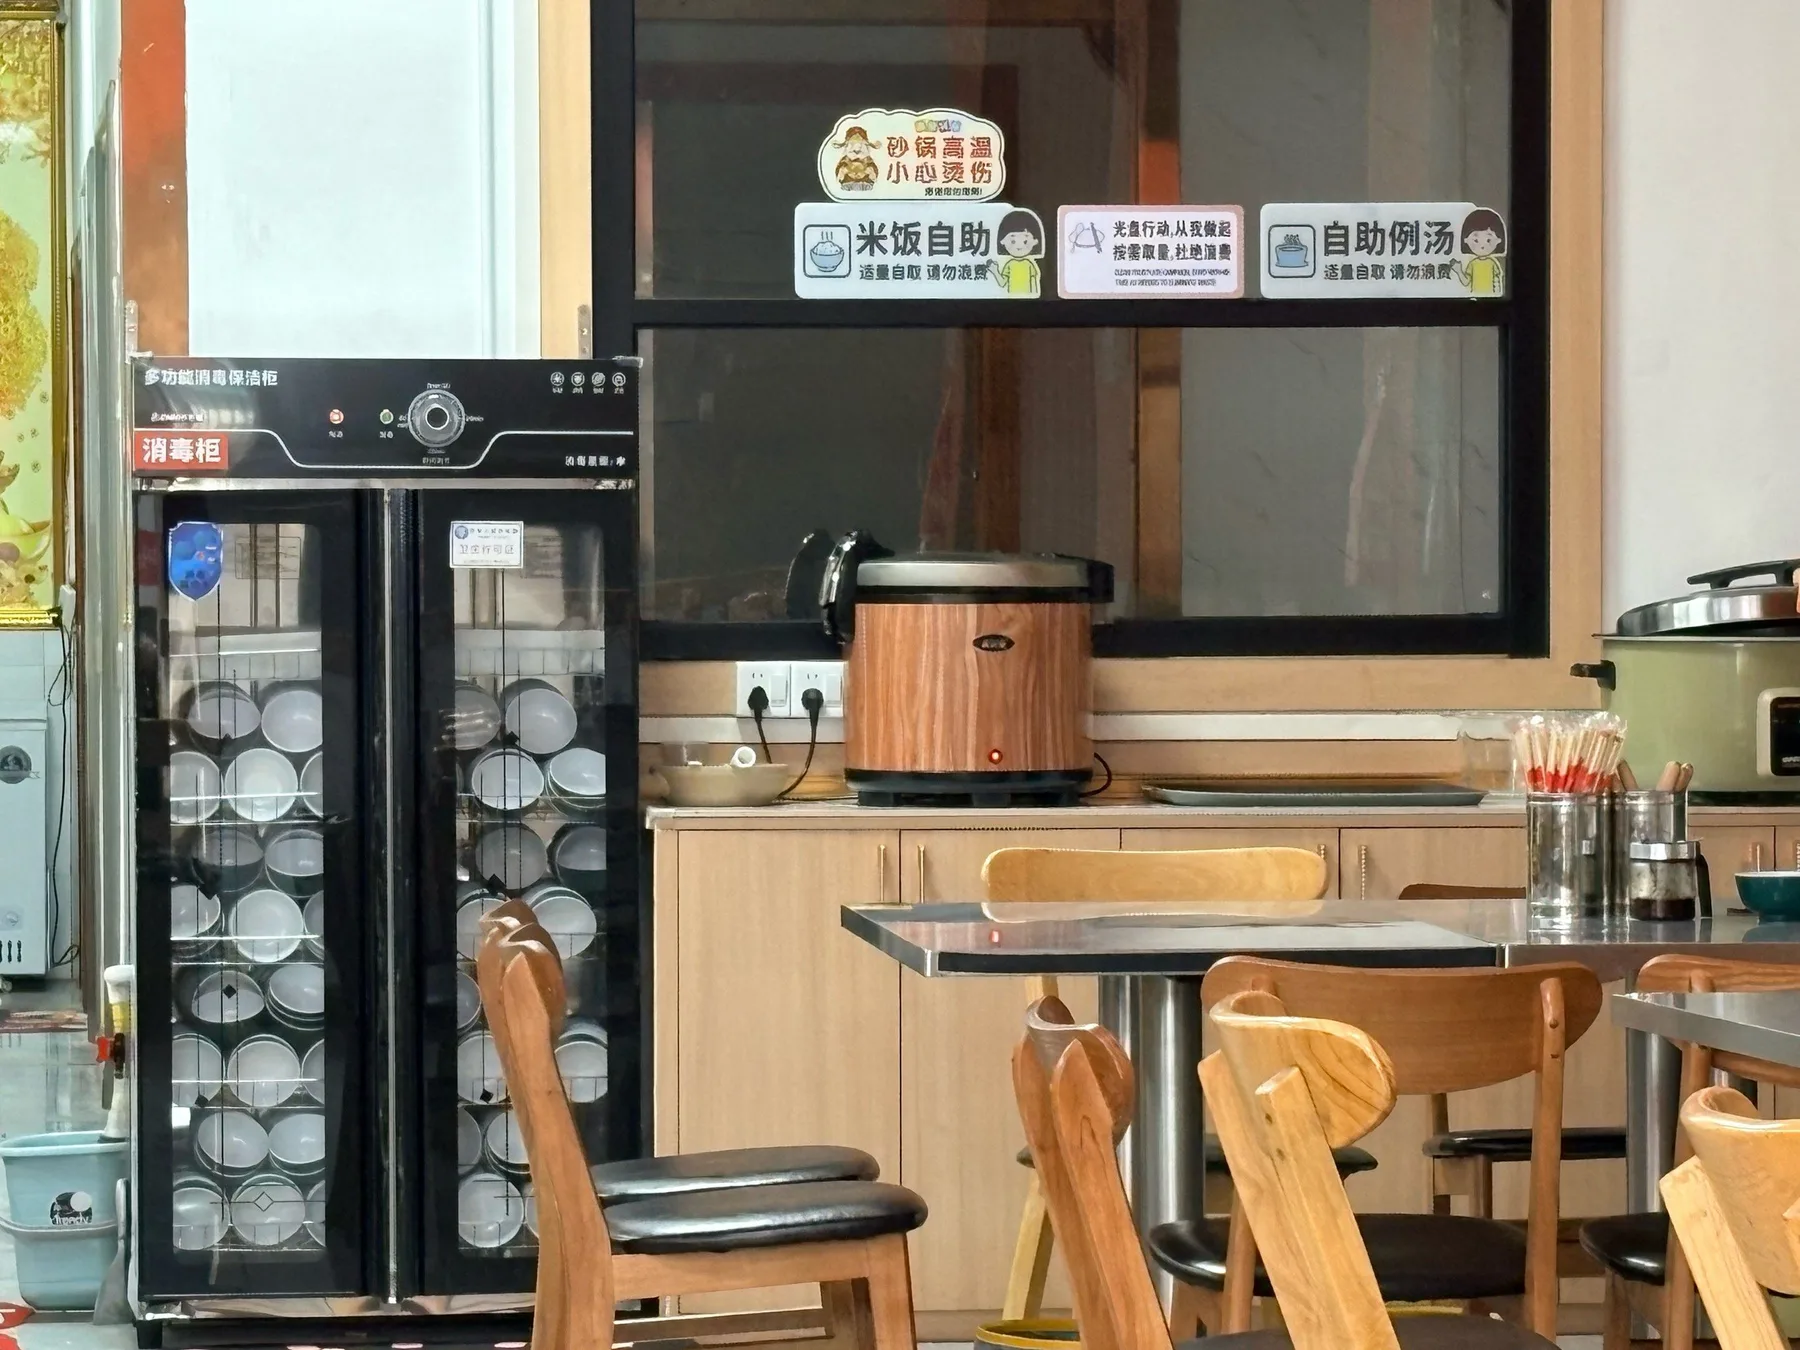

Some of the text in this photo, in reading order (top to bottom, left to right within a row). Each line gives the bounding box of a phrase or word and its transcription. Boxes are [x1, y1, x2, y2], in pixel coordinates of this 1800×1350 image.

[886, 135, 992, 159] 砂锅高温
[886, 161, 993, 184] 小心烫伤
[855, 220, 991, 257] 米饭自助
[1323, 220, 1454, 256] 自助例汤
[1323, 264, 1453, 281] 适量自取 请勿浪费
[143, 368, 279, 387] 多功能消毒保洁柜
[142, 437, 222, 464] 消毒柜
